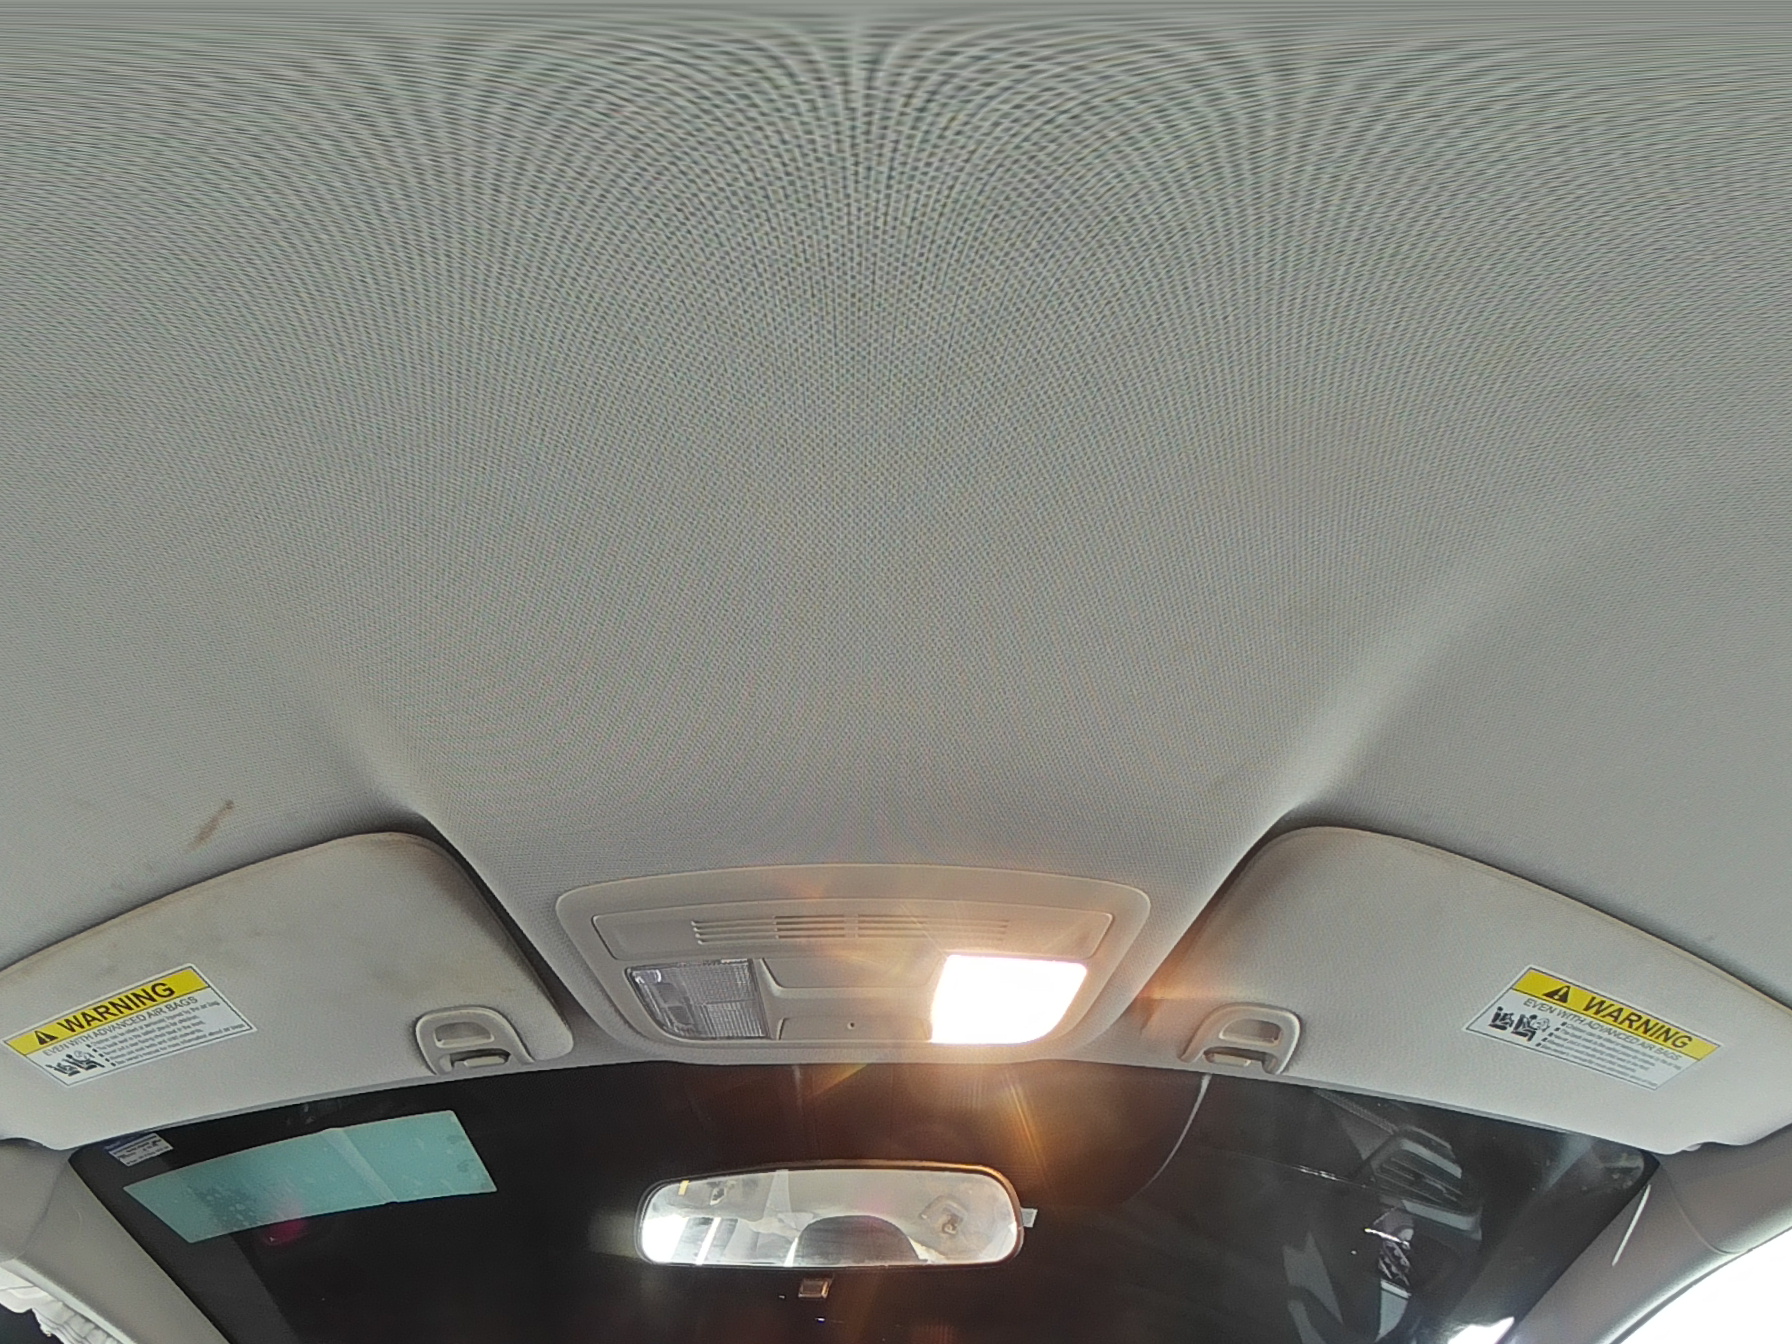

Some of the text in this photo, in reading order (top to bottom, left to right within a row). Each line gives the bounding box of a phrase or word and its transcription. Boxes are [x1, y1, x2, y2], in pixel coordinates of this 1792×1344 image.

[42, 996, 198, 1057] EVEN WITH ADVANCED AIR BAGS
[56, 982, 176, 1033] WARNING
[1523, 998, 1682, 1061] EVEN WITH ADVANCED AIR BAGS
[1583, 996, 1693, 1048] WARNING
